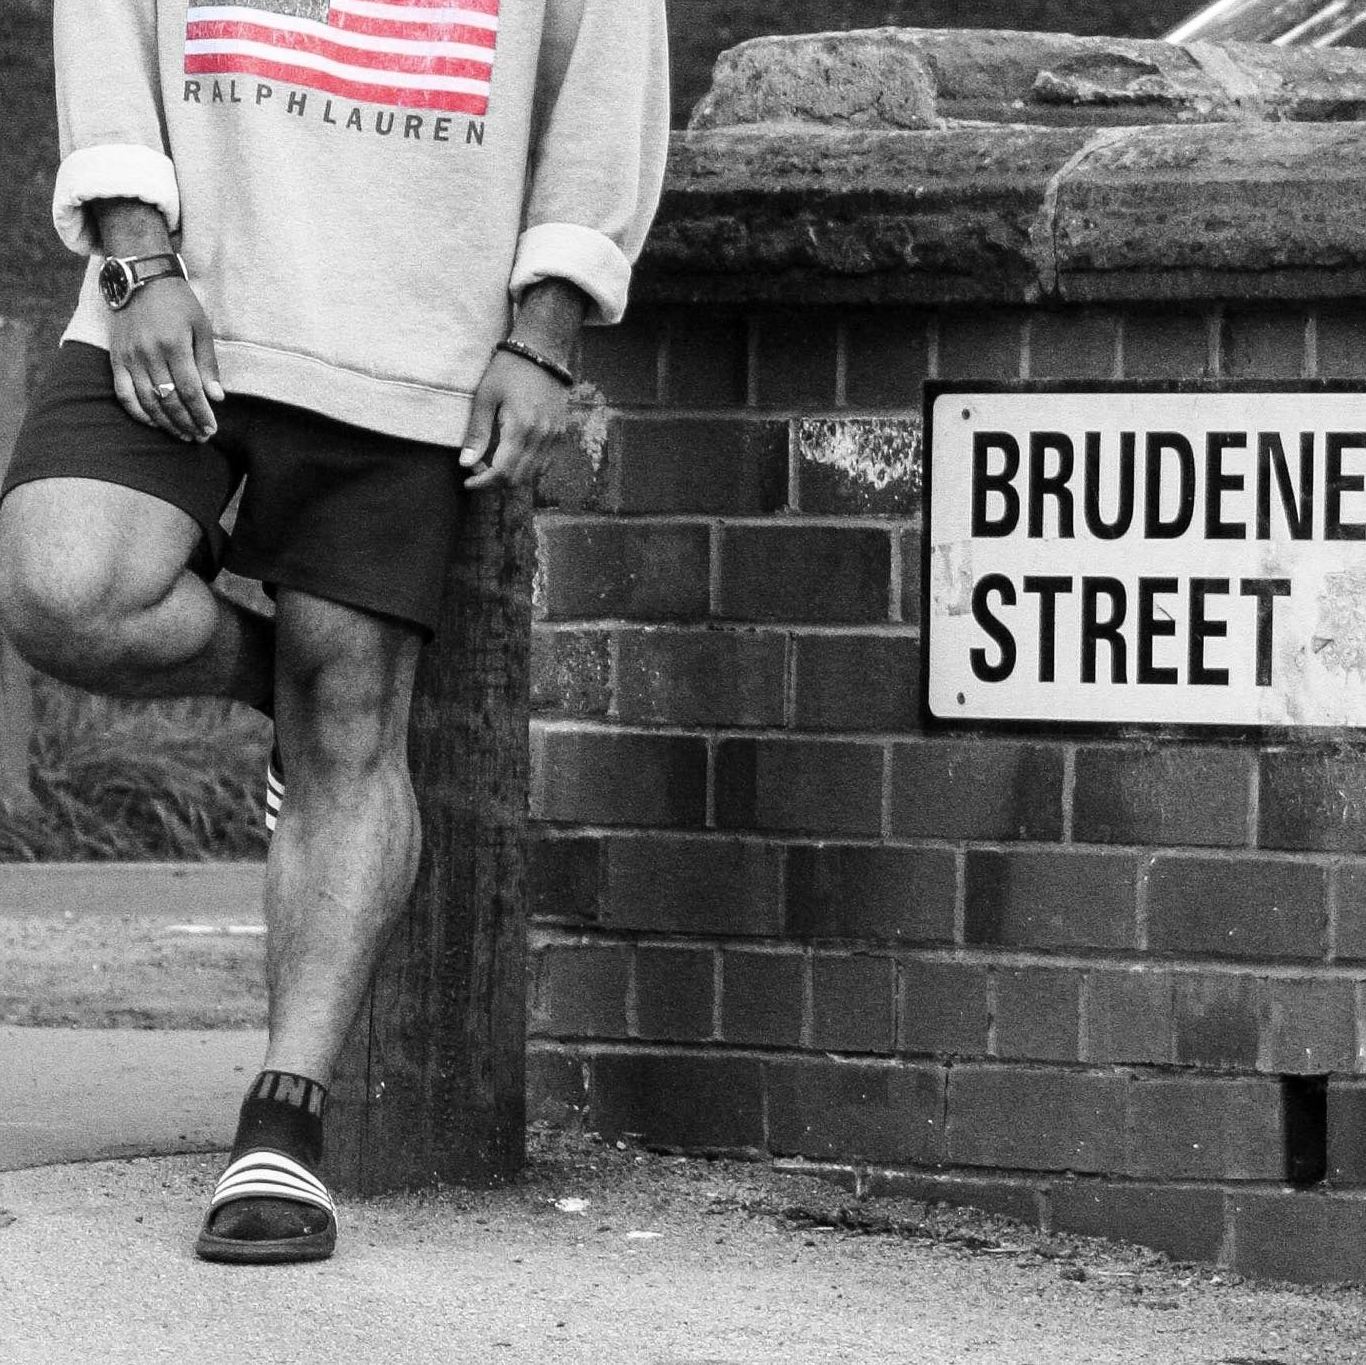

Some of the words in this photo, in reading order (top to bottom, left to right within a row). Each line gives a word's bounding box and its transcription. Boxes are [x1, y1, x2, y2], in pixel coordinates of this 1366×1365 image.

[183, 80, 307, 116] RALPH
[323, 100, 485, 146] LAUREN
[969, 573, 1291, 686] STREET
